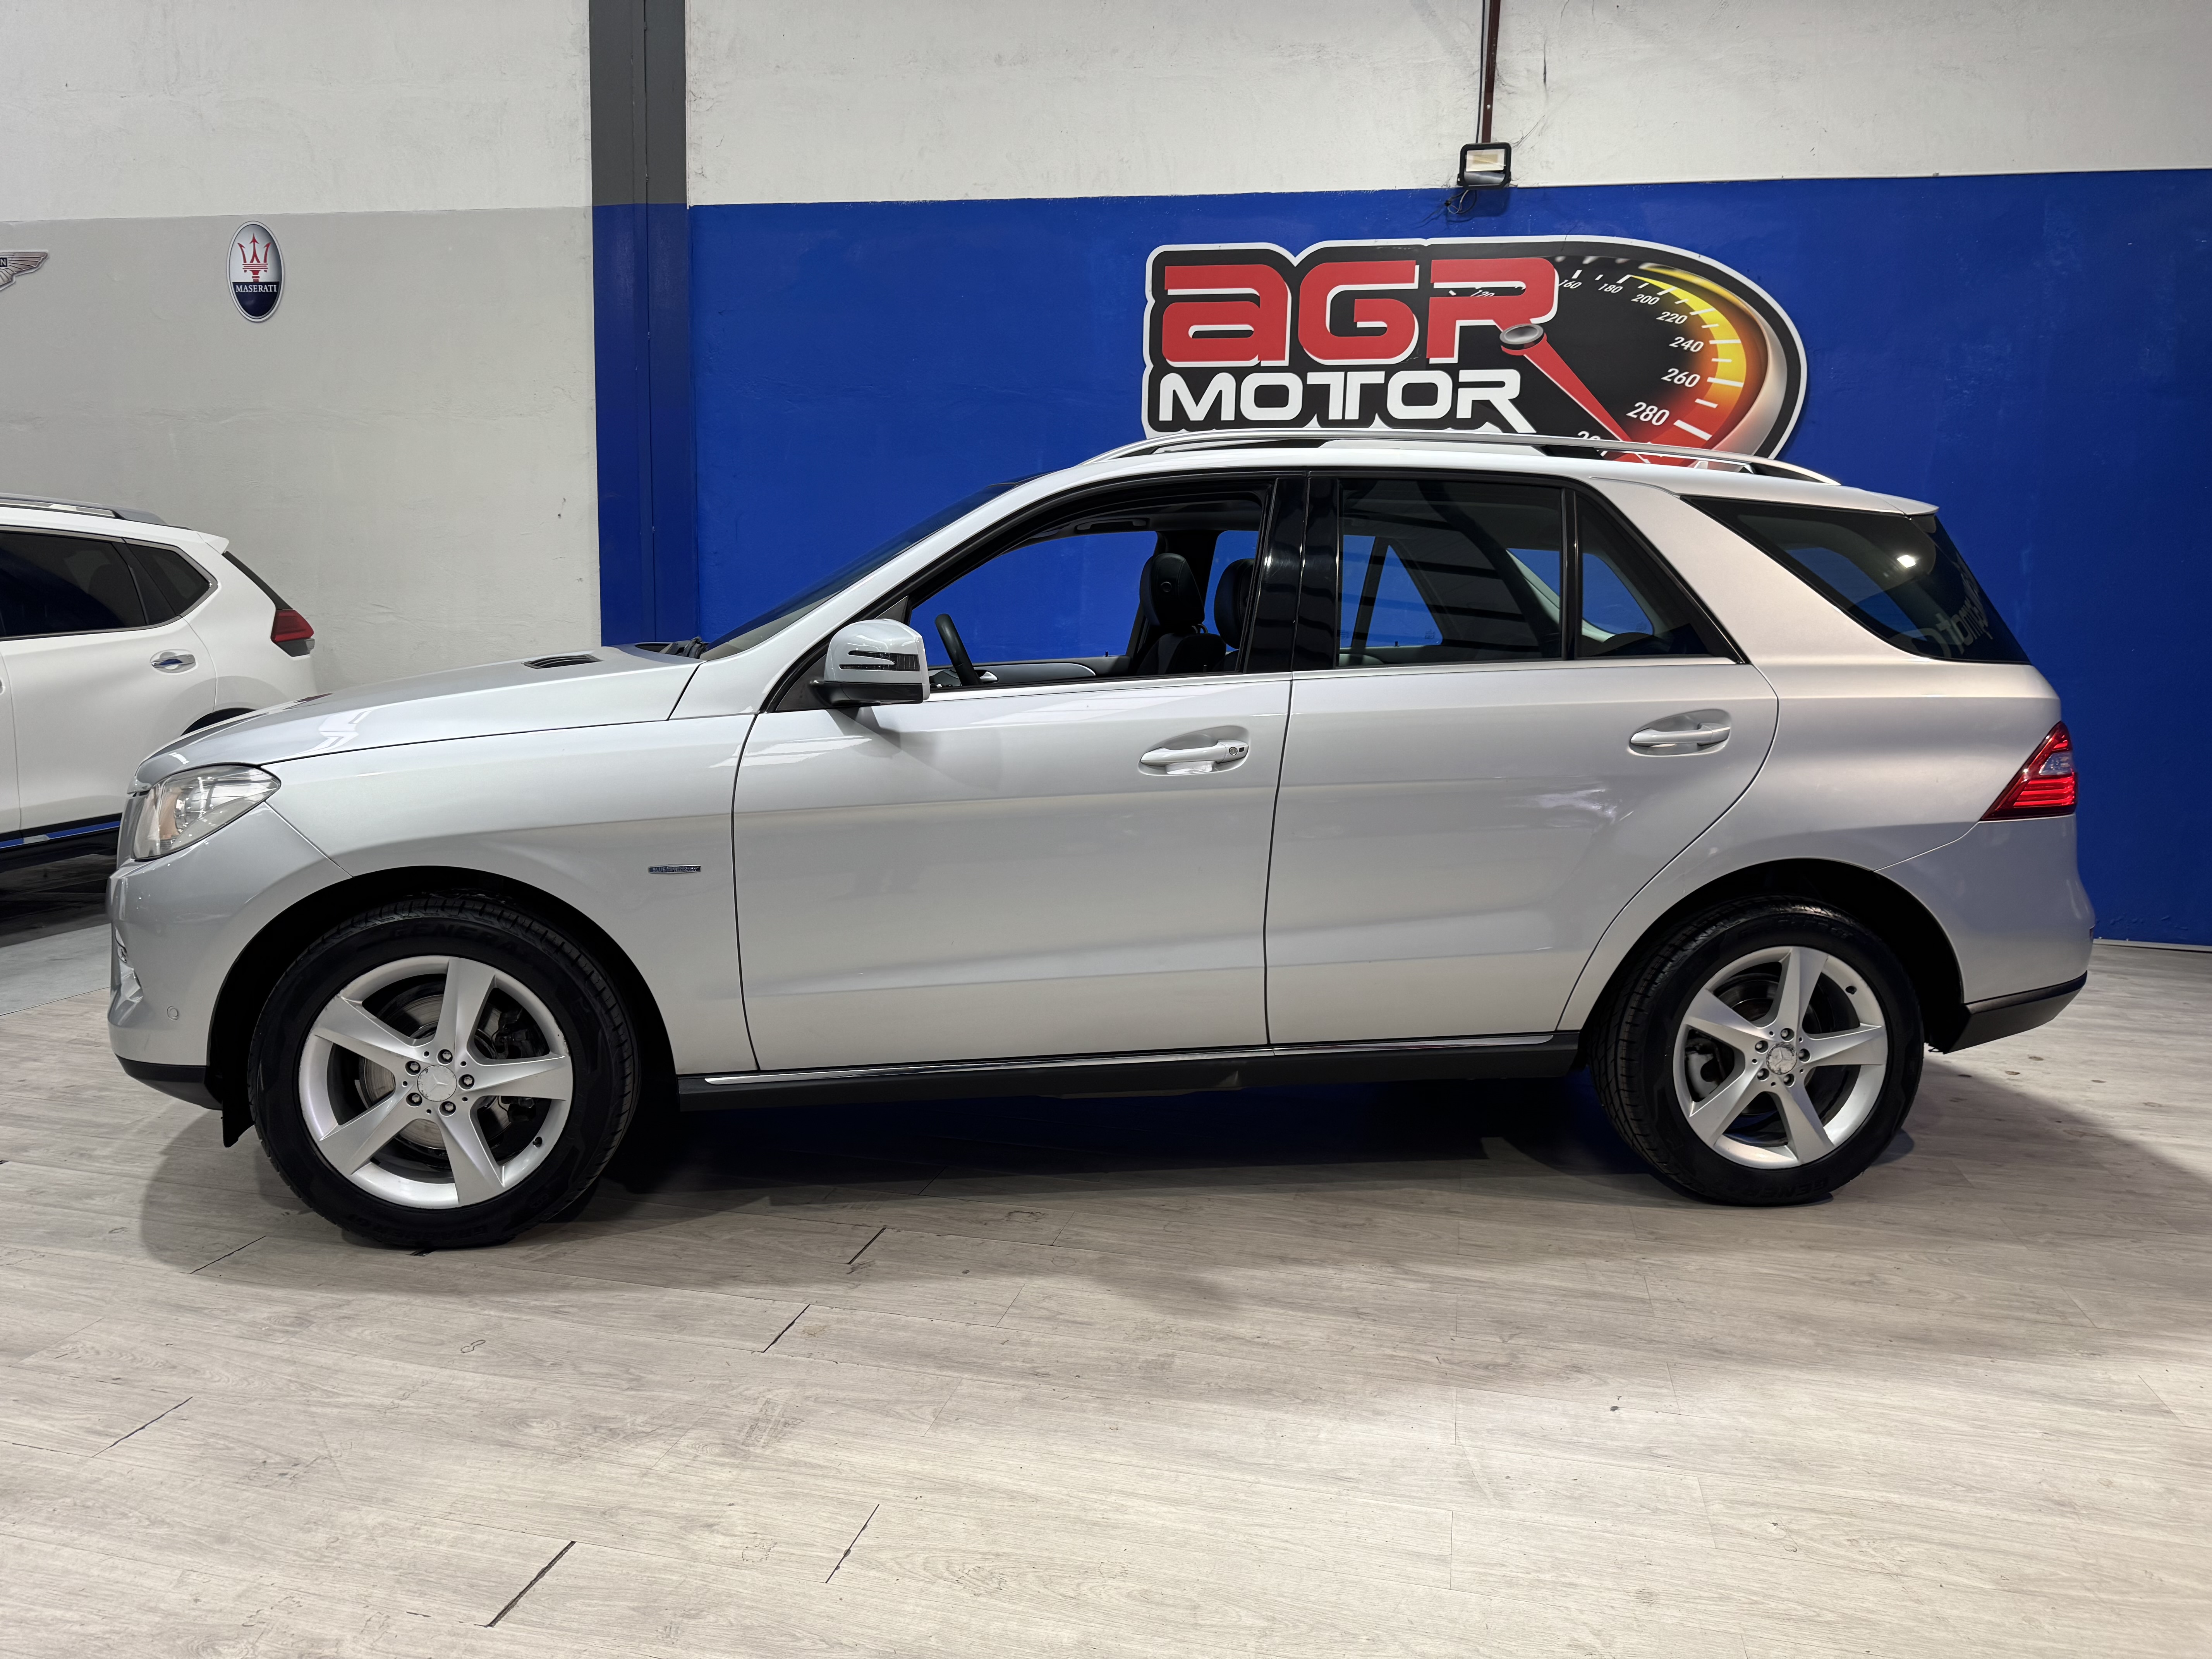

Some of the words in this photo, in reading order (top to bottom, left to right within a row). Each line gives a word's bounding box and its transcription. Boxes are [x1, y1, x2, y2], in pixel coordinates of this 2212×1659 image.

[1559, 280, 1582, 289] 160
[1598, 283, 1623, 294] 180
[1631, 294, 1660, 305] 200
[1656, 311, 1688, 325] 220
[1669, 337, 1704, 352] 240
[1661, 368, 1701, 388] 260
[1159, 369, 1537, 434] MOTOR
[1626, 402, 1670, 426] 280
